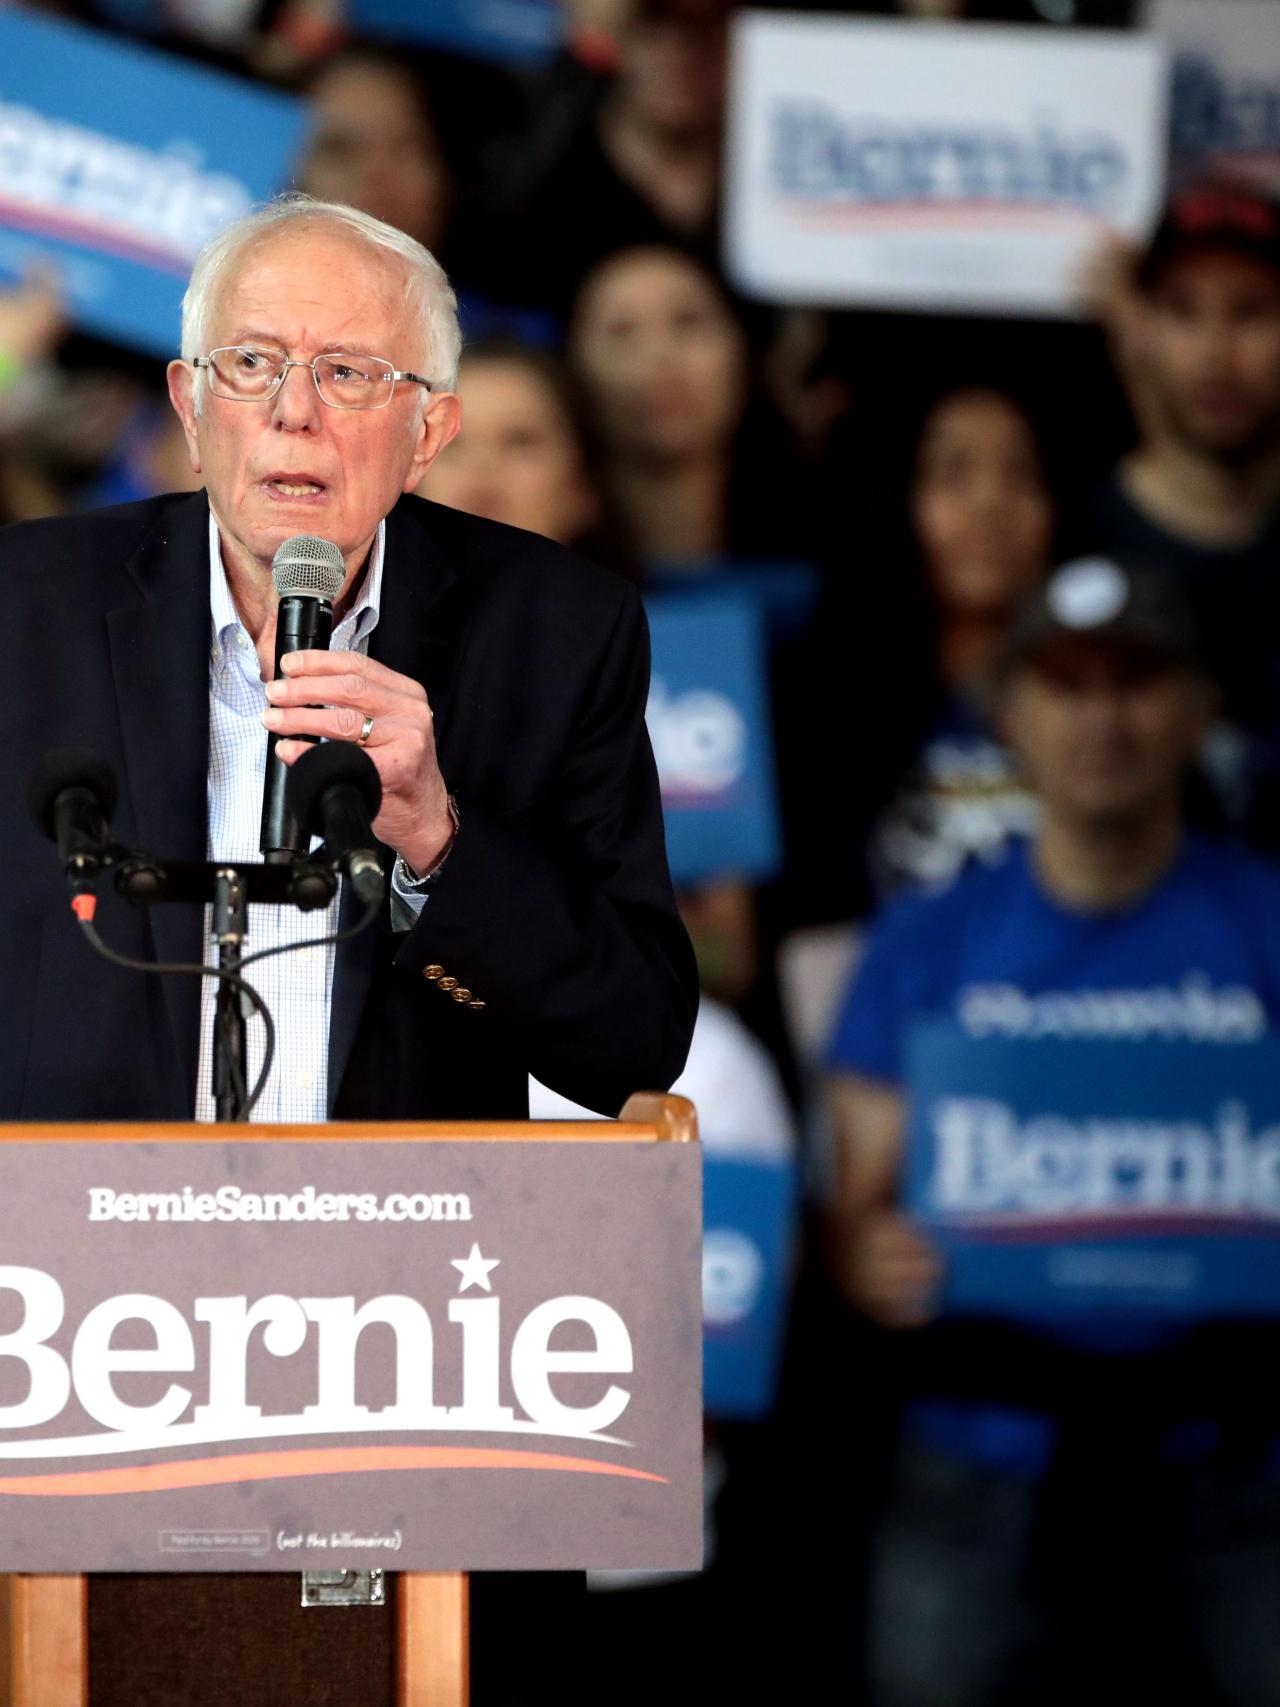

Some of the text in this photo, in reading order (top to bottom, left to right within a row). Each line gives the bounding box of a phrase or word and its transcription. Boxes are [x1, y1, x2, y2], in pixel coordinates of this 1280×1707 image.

[88, 1186, 473, 1222] BernieSanders.com
[276, 1530, 403, 1551] (not the billionaires)
